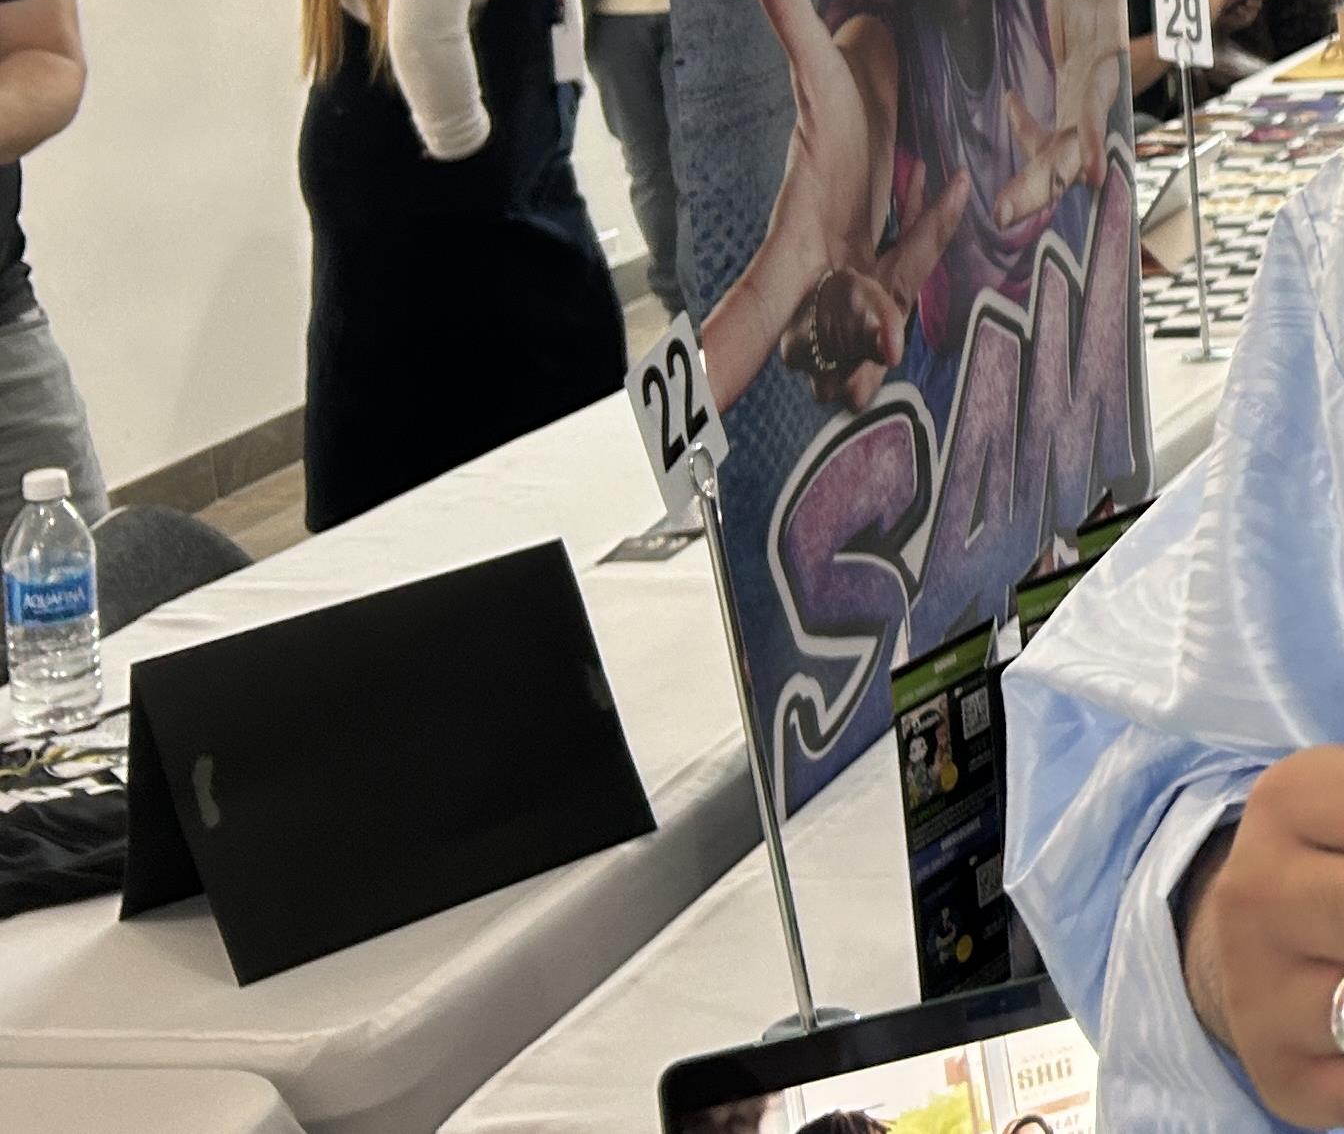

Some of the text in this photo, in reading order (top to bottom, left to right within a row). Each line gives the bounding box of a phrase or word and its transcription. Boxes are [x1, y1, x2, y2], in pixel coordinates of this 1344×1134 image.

[641, 337, 710, 474] 22
[768, 131, 1153, 816] SAM
[22, 586, 86, 611] AQUAFINA
